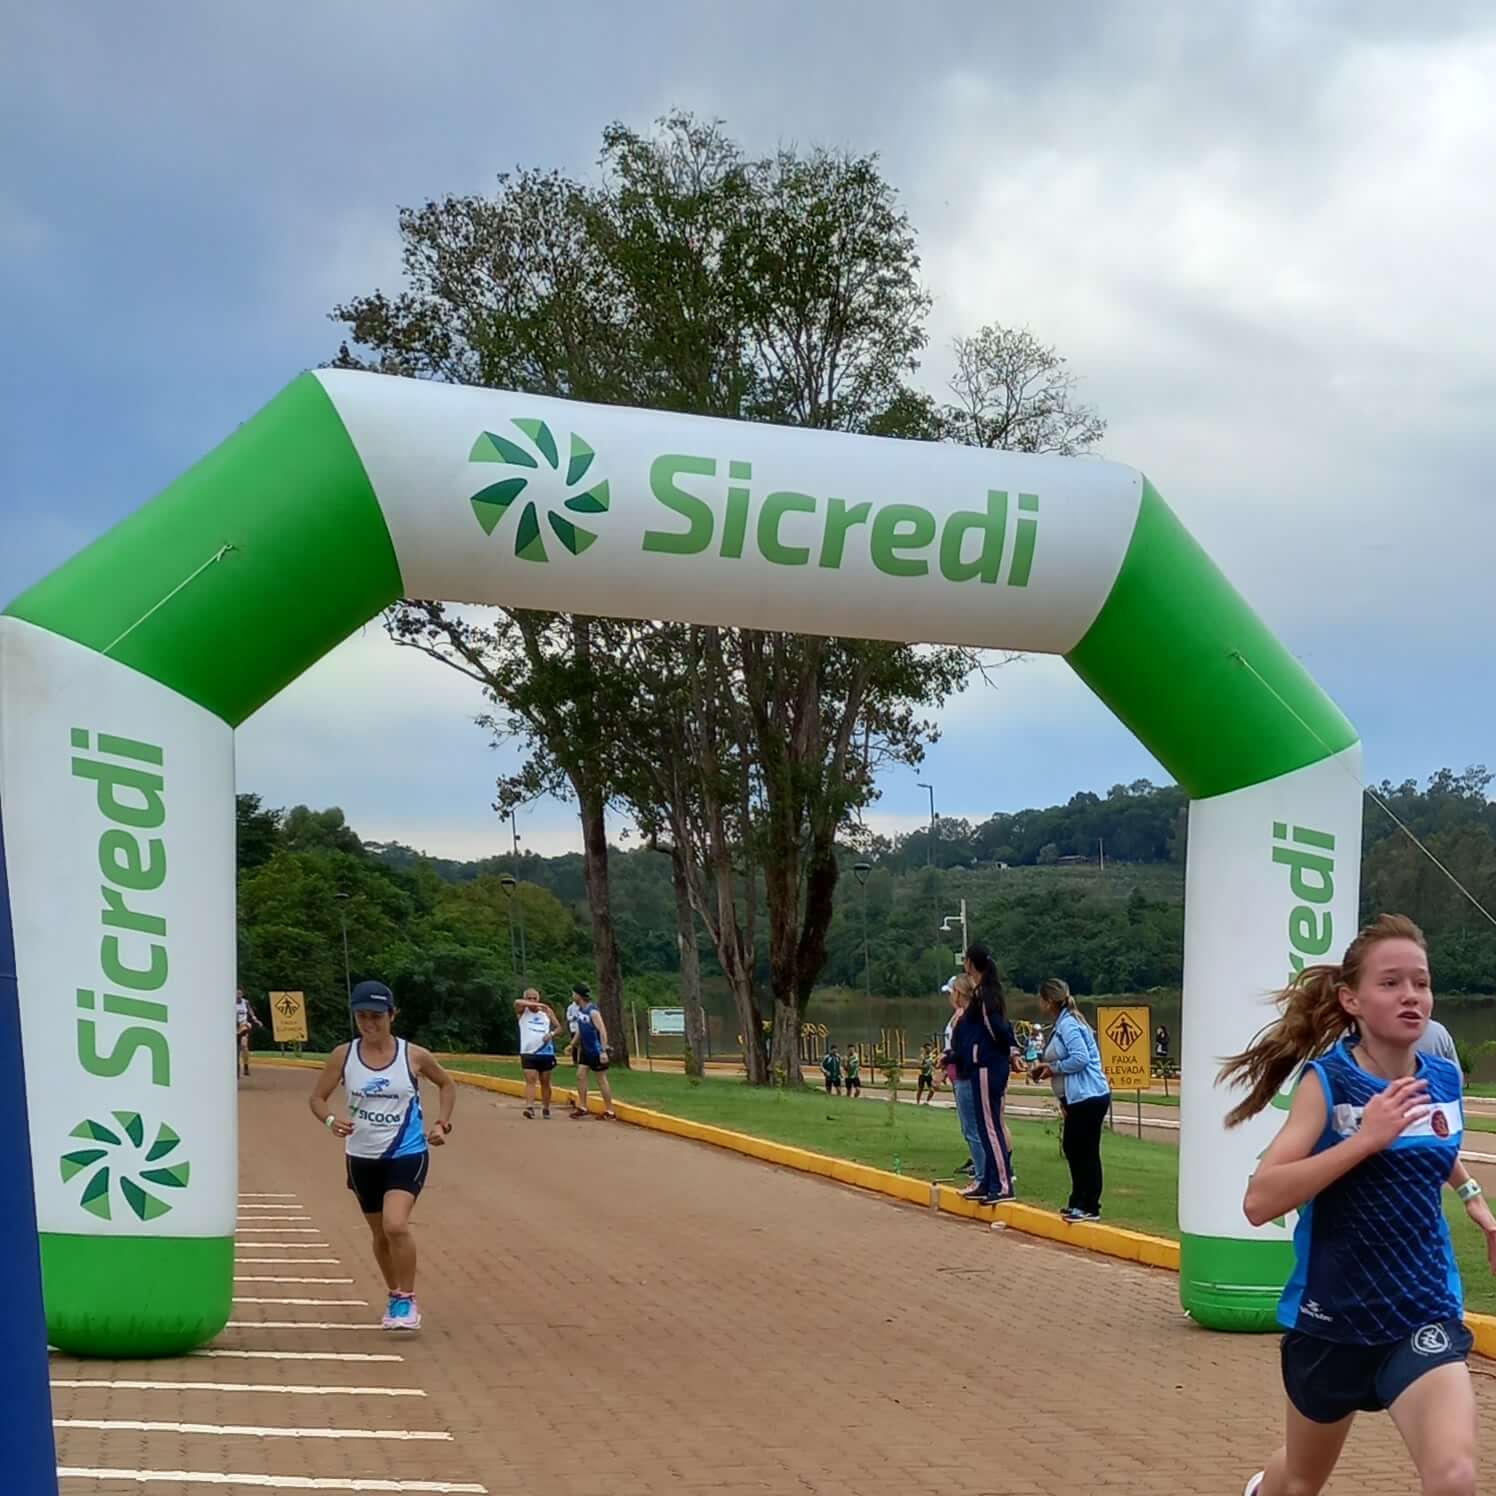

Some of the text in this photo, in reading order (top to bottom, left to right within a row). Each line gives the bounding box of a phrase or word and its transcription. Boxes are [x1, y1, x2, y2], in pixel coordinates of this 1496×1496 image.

[642, 454, 1039, 588] Sicredi
[70, 728, 171, 1087] Sicredi
[1104, 1065, 1145, 1074] ELEVADA
[1111, 1055, 1138, 1064] FAIXA
